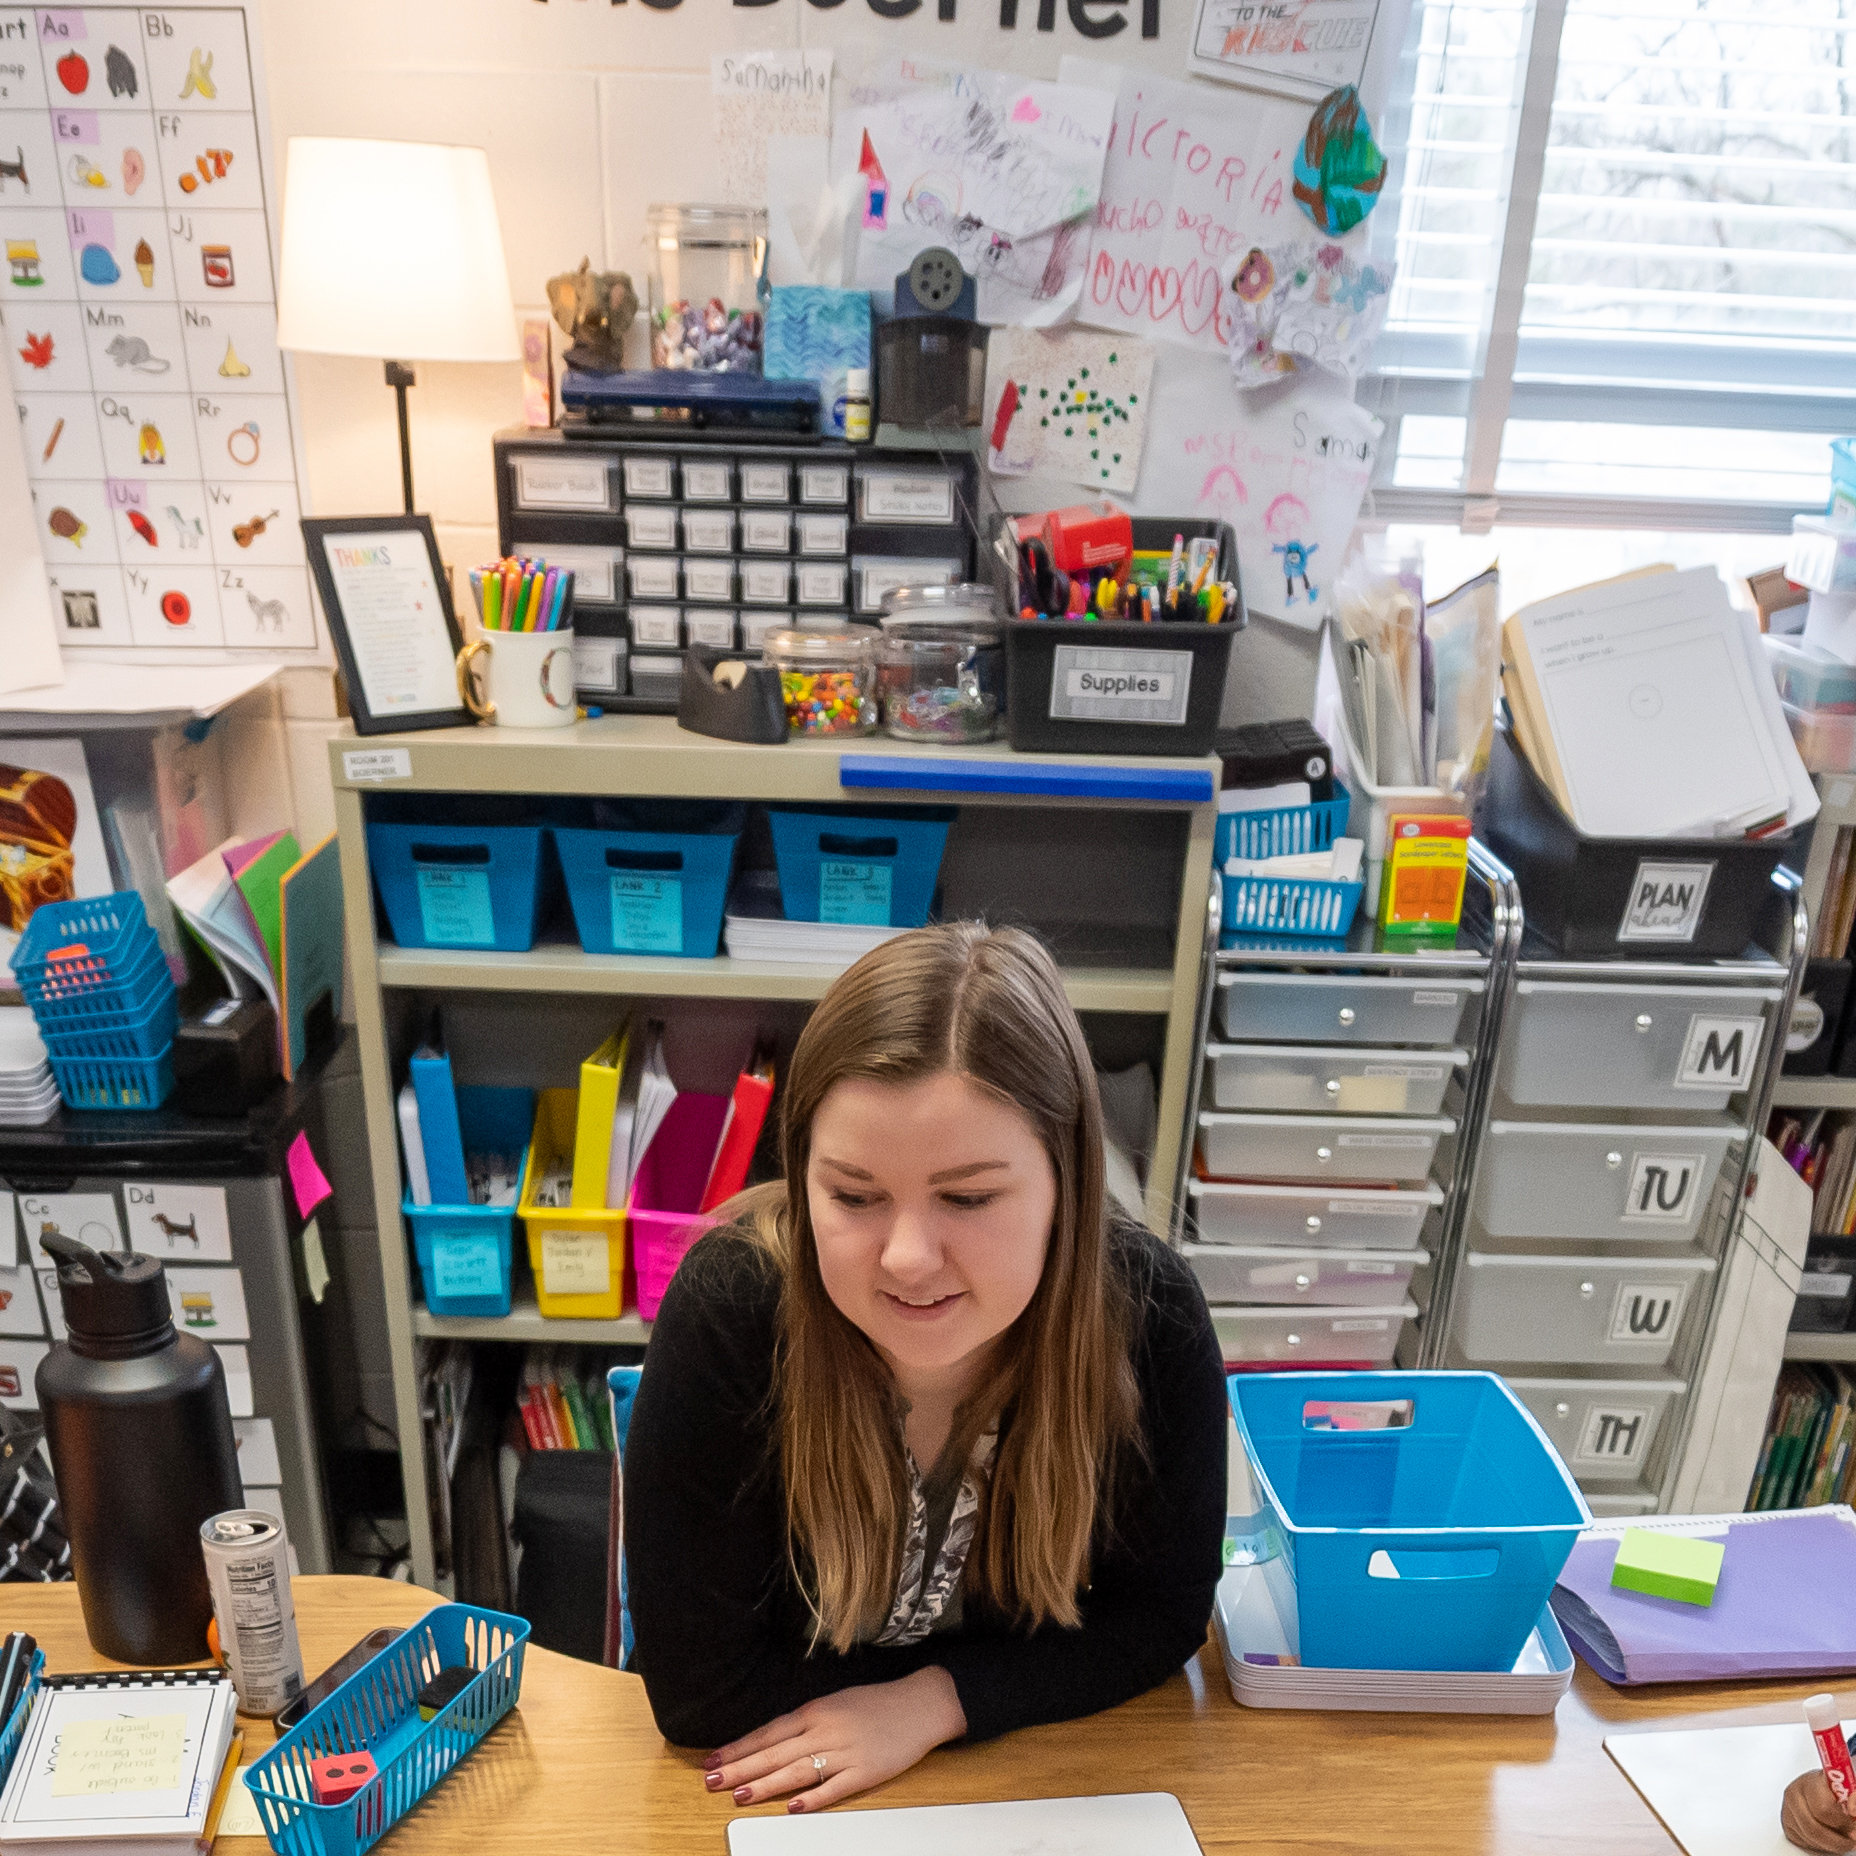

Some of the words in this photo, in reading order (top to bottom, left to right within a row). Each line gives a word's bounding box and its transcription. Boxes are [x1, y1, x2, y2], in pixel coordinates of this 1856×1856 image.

[1231, 7, 1254, 21] TO
[1259, 5, 1288, 20] THE
[43, 16, 70, 37] Aa
[145, 15, 174, 37] Bb
[57, 115, 80, 138] Ee
[159, 116, 182, 136] Ff
[171, 215, 193, 242] Jj
[86, 308, 124, 327] Mm
[185, 308, 211, 327] Nn
[101, 398, 134, 425] Qq
[197, 398, 221, 417] Rr
[113, 485, 140, 505] Uu
[209, 486, 232, 505] Vv
[334, 546, 392, 568] THANKS
[128, 570, 148, 594] Yy
[221, 570, 244, 588] Zz
[1080, 673, 1160, 695] Supplies
[1637, 883, 1695, 911] PLAN
[1697, 1028, 1744, 1077] M
[129, 1186, 155, 1206] Dd
[1640, 1165, 1691, 1212] TU
[24, 1198, 50, 1217] Cc
[1629, 1295, 1672, 1334] W
[1595, 1413, 1642, 1455] TH
